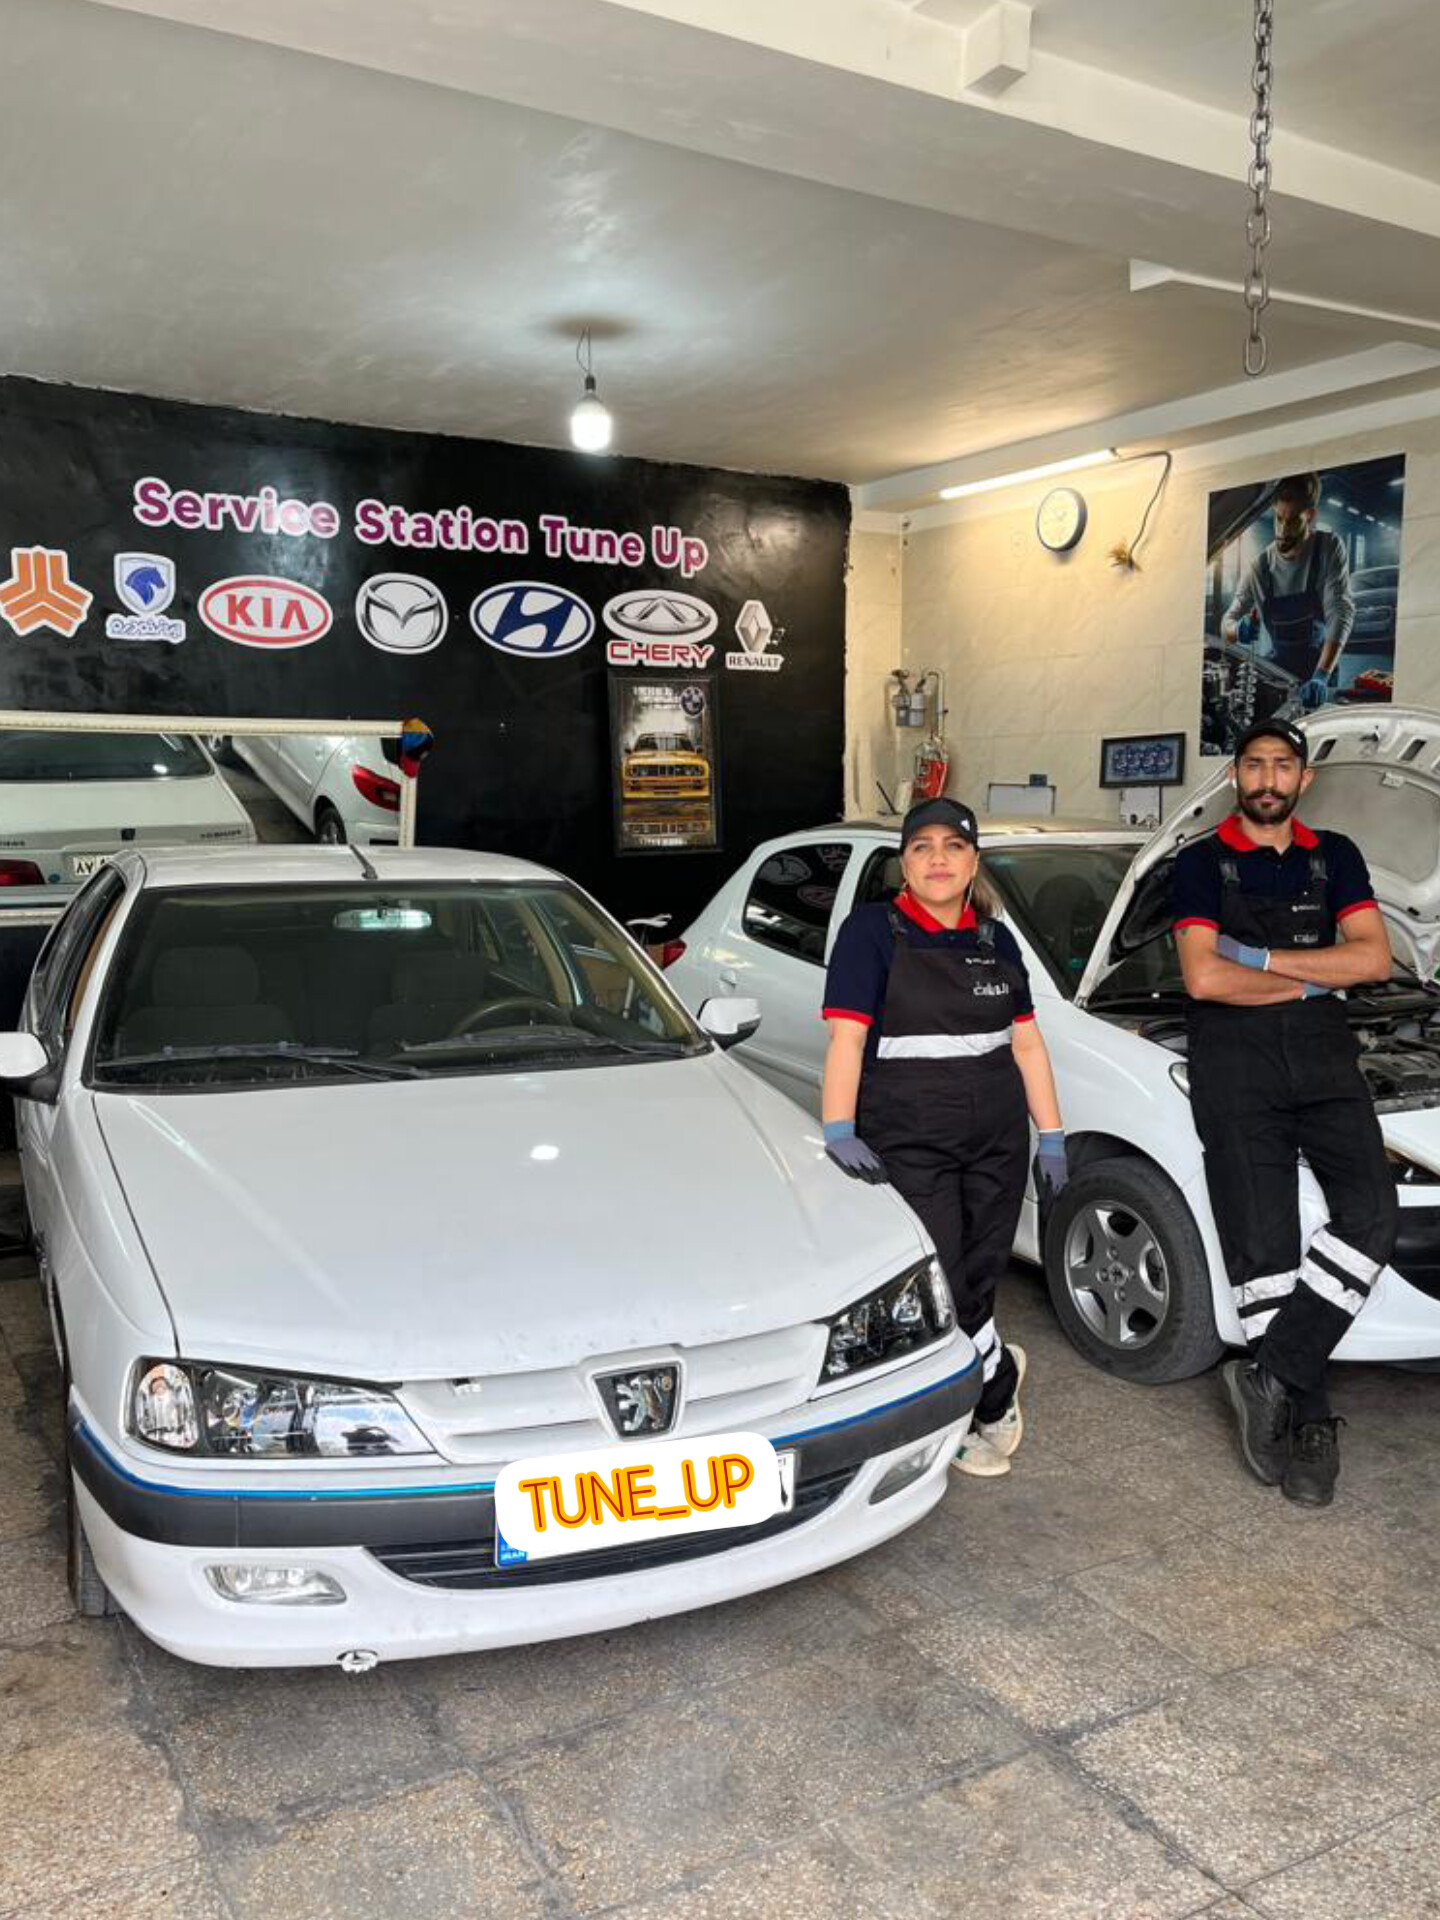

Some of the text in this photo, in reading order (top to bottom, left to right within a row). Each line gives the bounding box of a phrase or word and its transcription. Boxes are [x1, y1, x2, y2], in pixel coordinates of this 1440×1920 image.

[136, 479, 707, 576] Service Station Tune Up
[227, 594, 308, 630] KIA
[610, 641, 712, 665] CHERY
[728, 655, 780, 668] RENAULT
